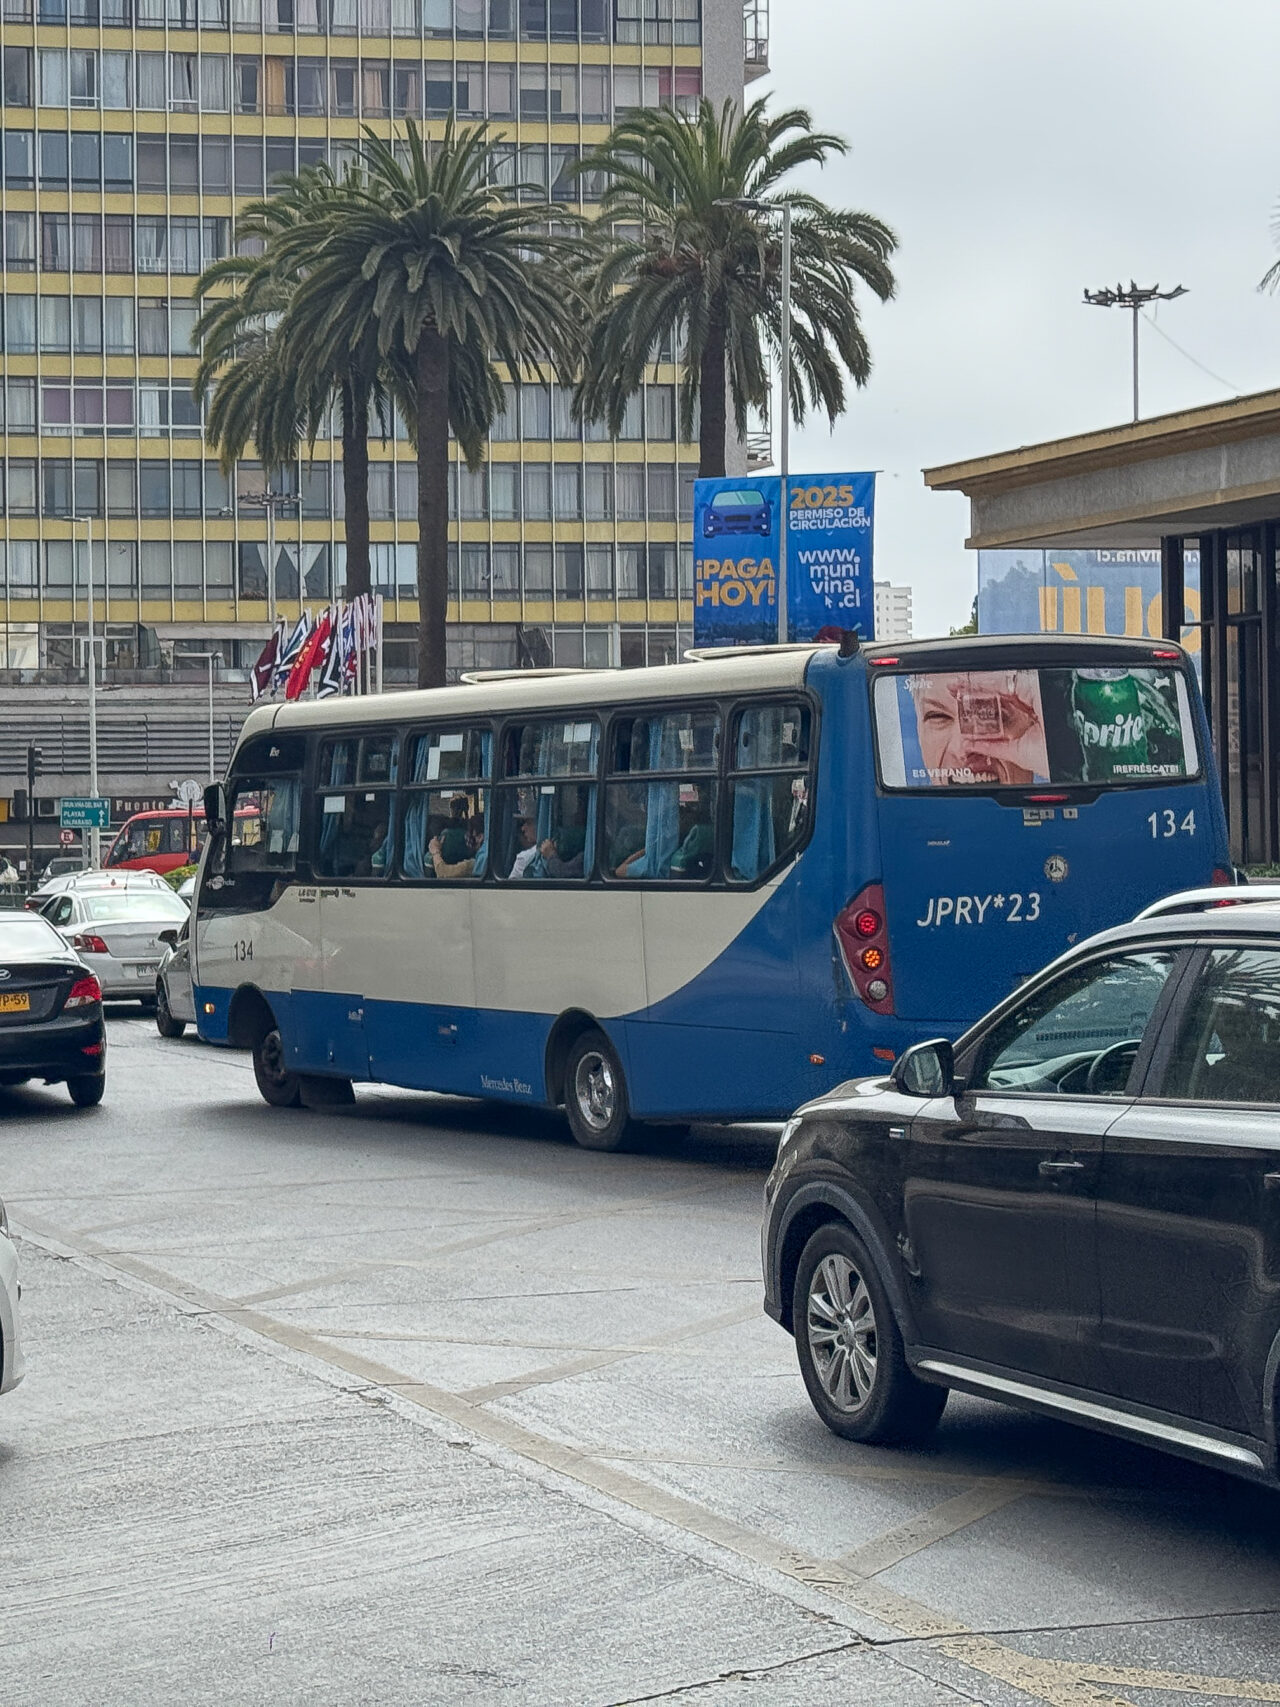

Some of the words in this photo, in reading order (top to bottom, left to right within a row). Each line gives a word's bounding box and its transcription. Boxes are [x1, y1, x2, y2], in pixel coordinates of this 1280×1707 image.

[790, 486, 854, 508] 2025
[789, 508, 843, 521] PERMISO
[849, 507, 865, 518] DE
[798, 548, 861, 564] www.
[696, 557, 775, 580] ¡PAGA
[810, 563, 859, 578] muni
[695, 580, 775, 607] HOY!
[838, 589, 860, 607] .cl
[912, 769, 926, 778] ES
[116, 800, 165, 811] Fuente
[1147, 809, 1197, 839] 134
[233, 939, 253, 961] 134
